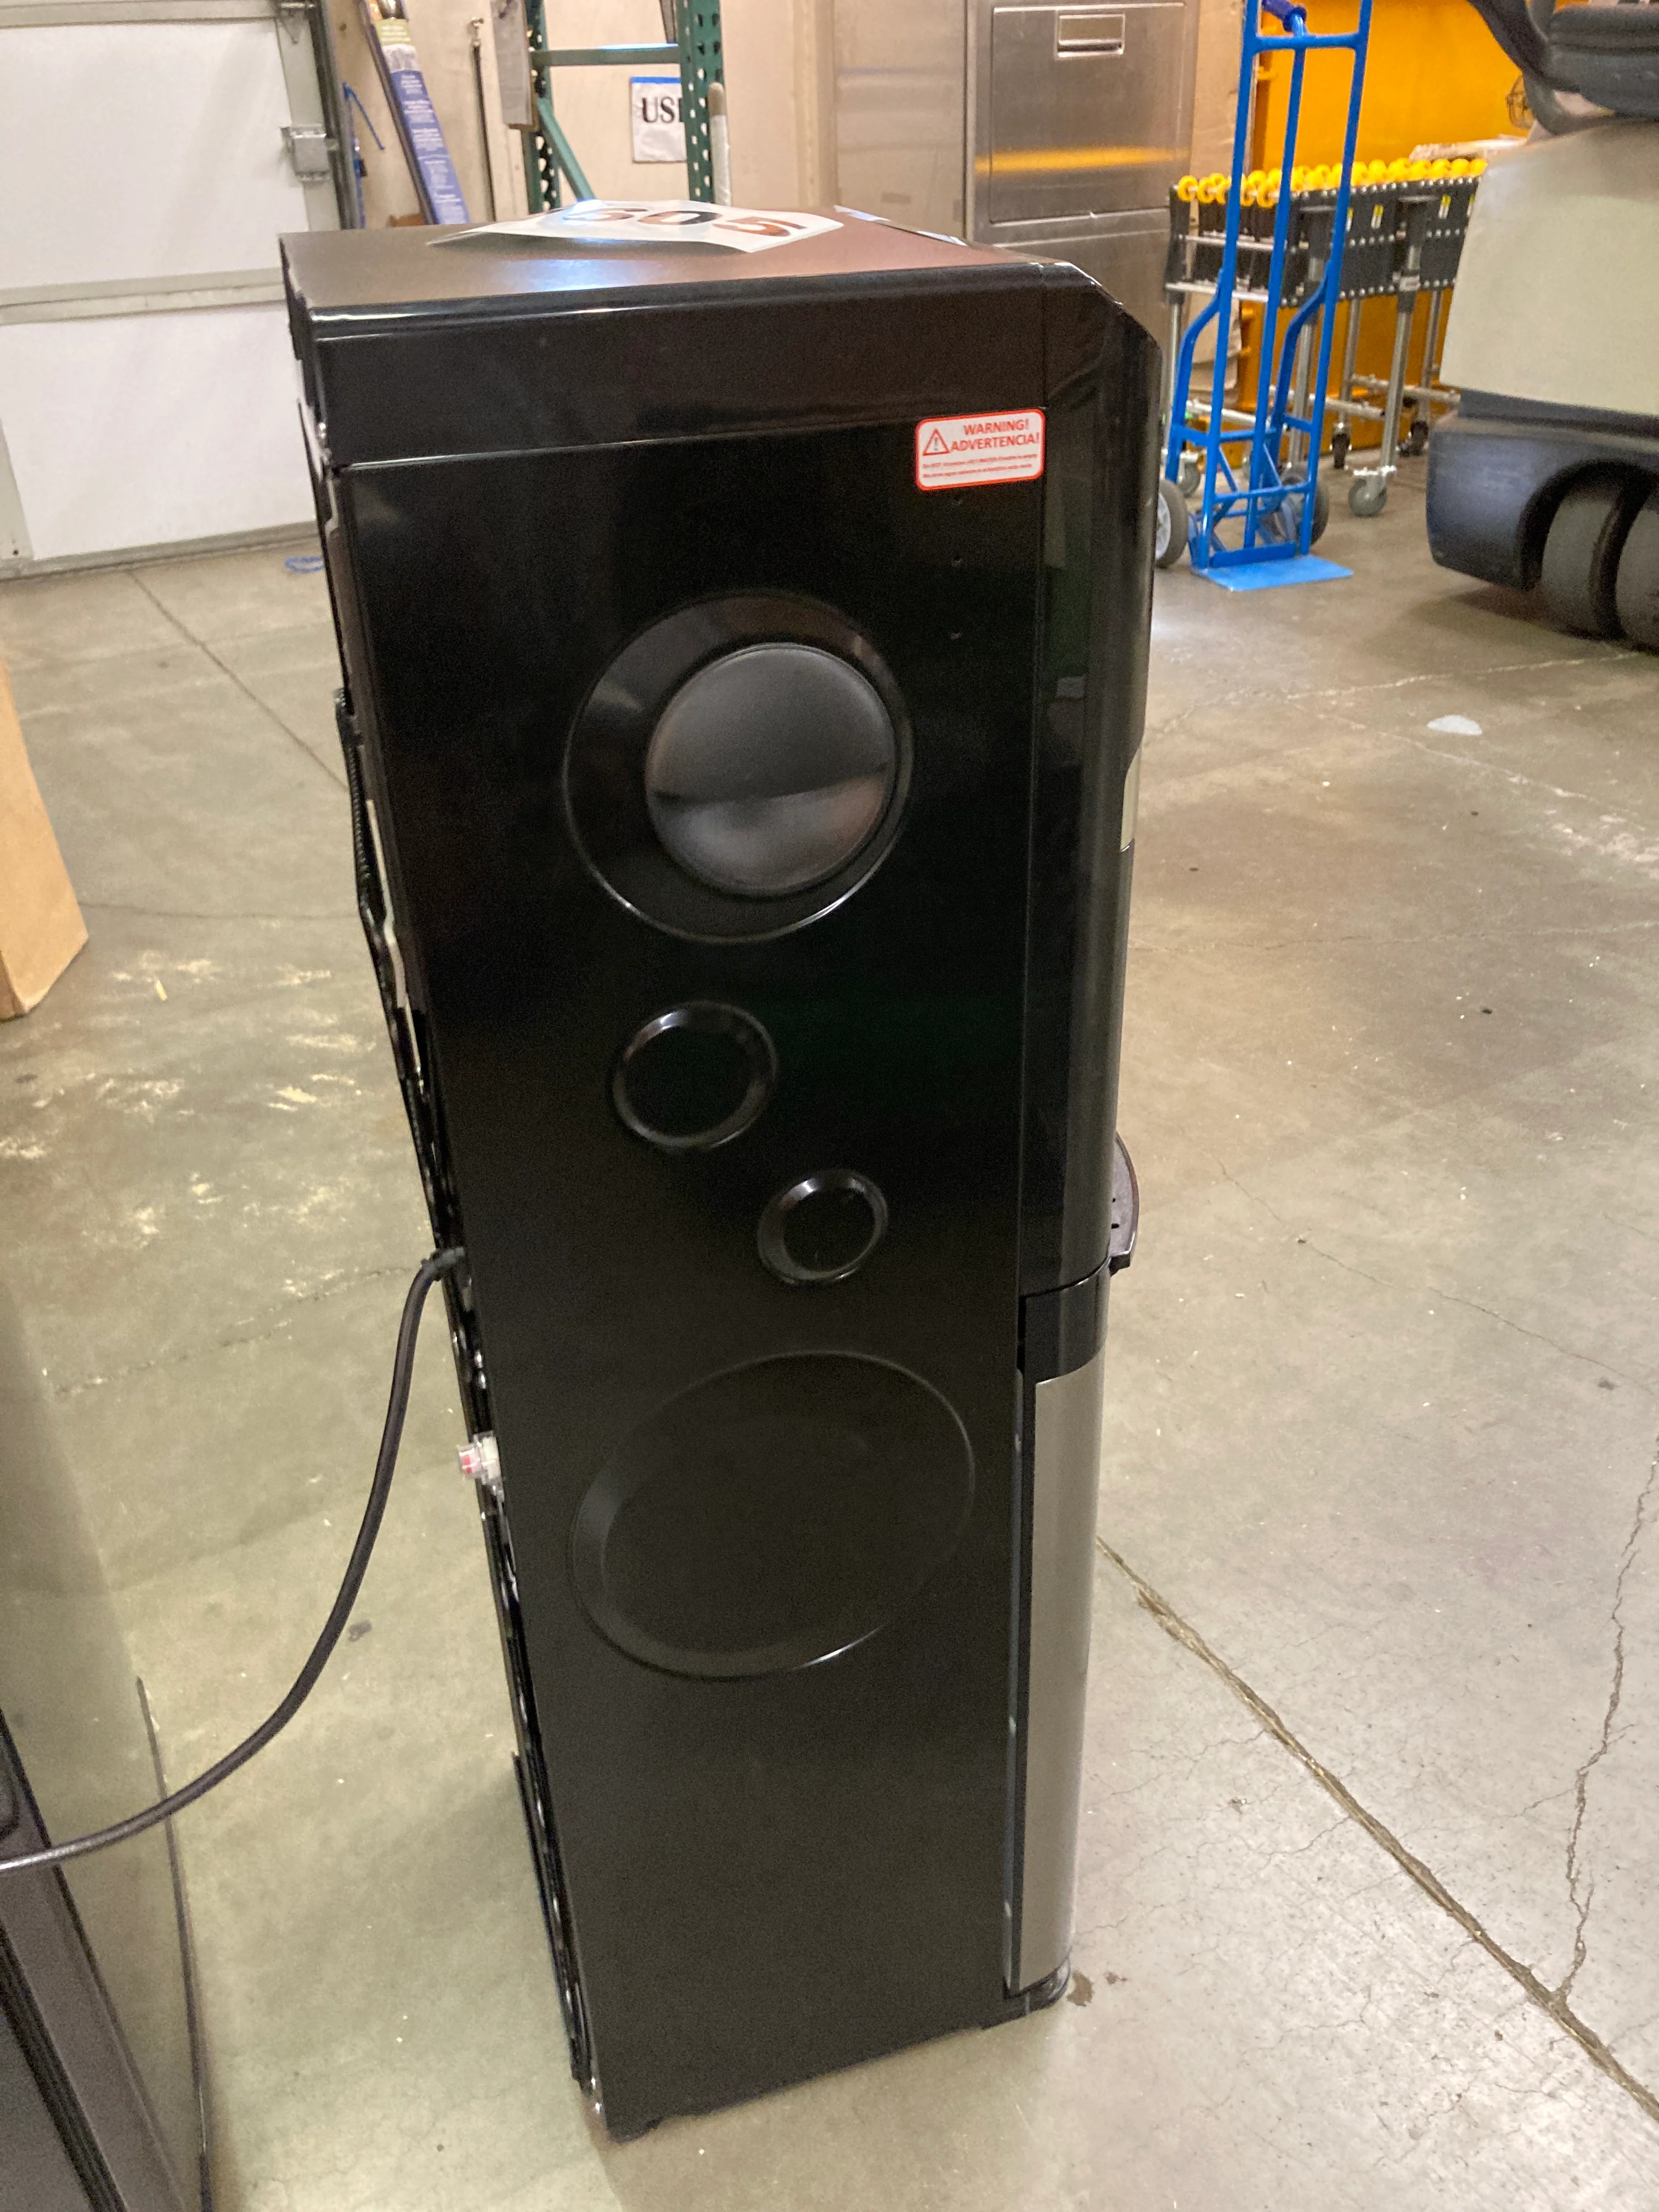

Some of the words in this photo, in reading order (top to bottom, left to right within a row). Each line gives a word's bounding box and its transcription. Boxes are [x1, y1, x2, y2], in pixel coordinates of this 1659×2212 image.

[642, 96, 684, 123] US
[963, 419, 1030, 435] WARNING!
[951, 432, 1040, 452] ADVERTENCIA!
